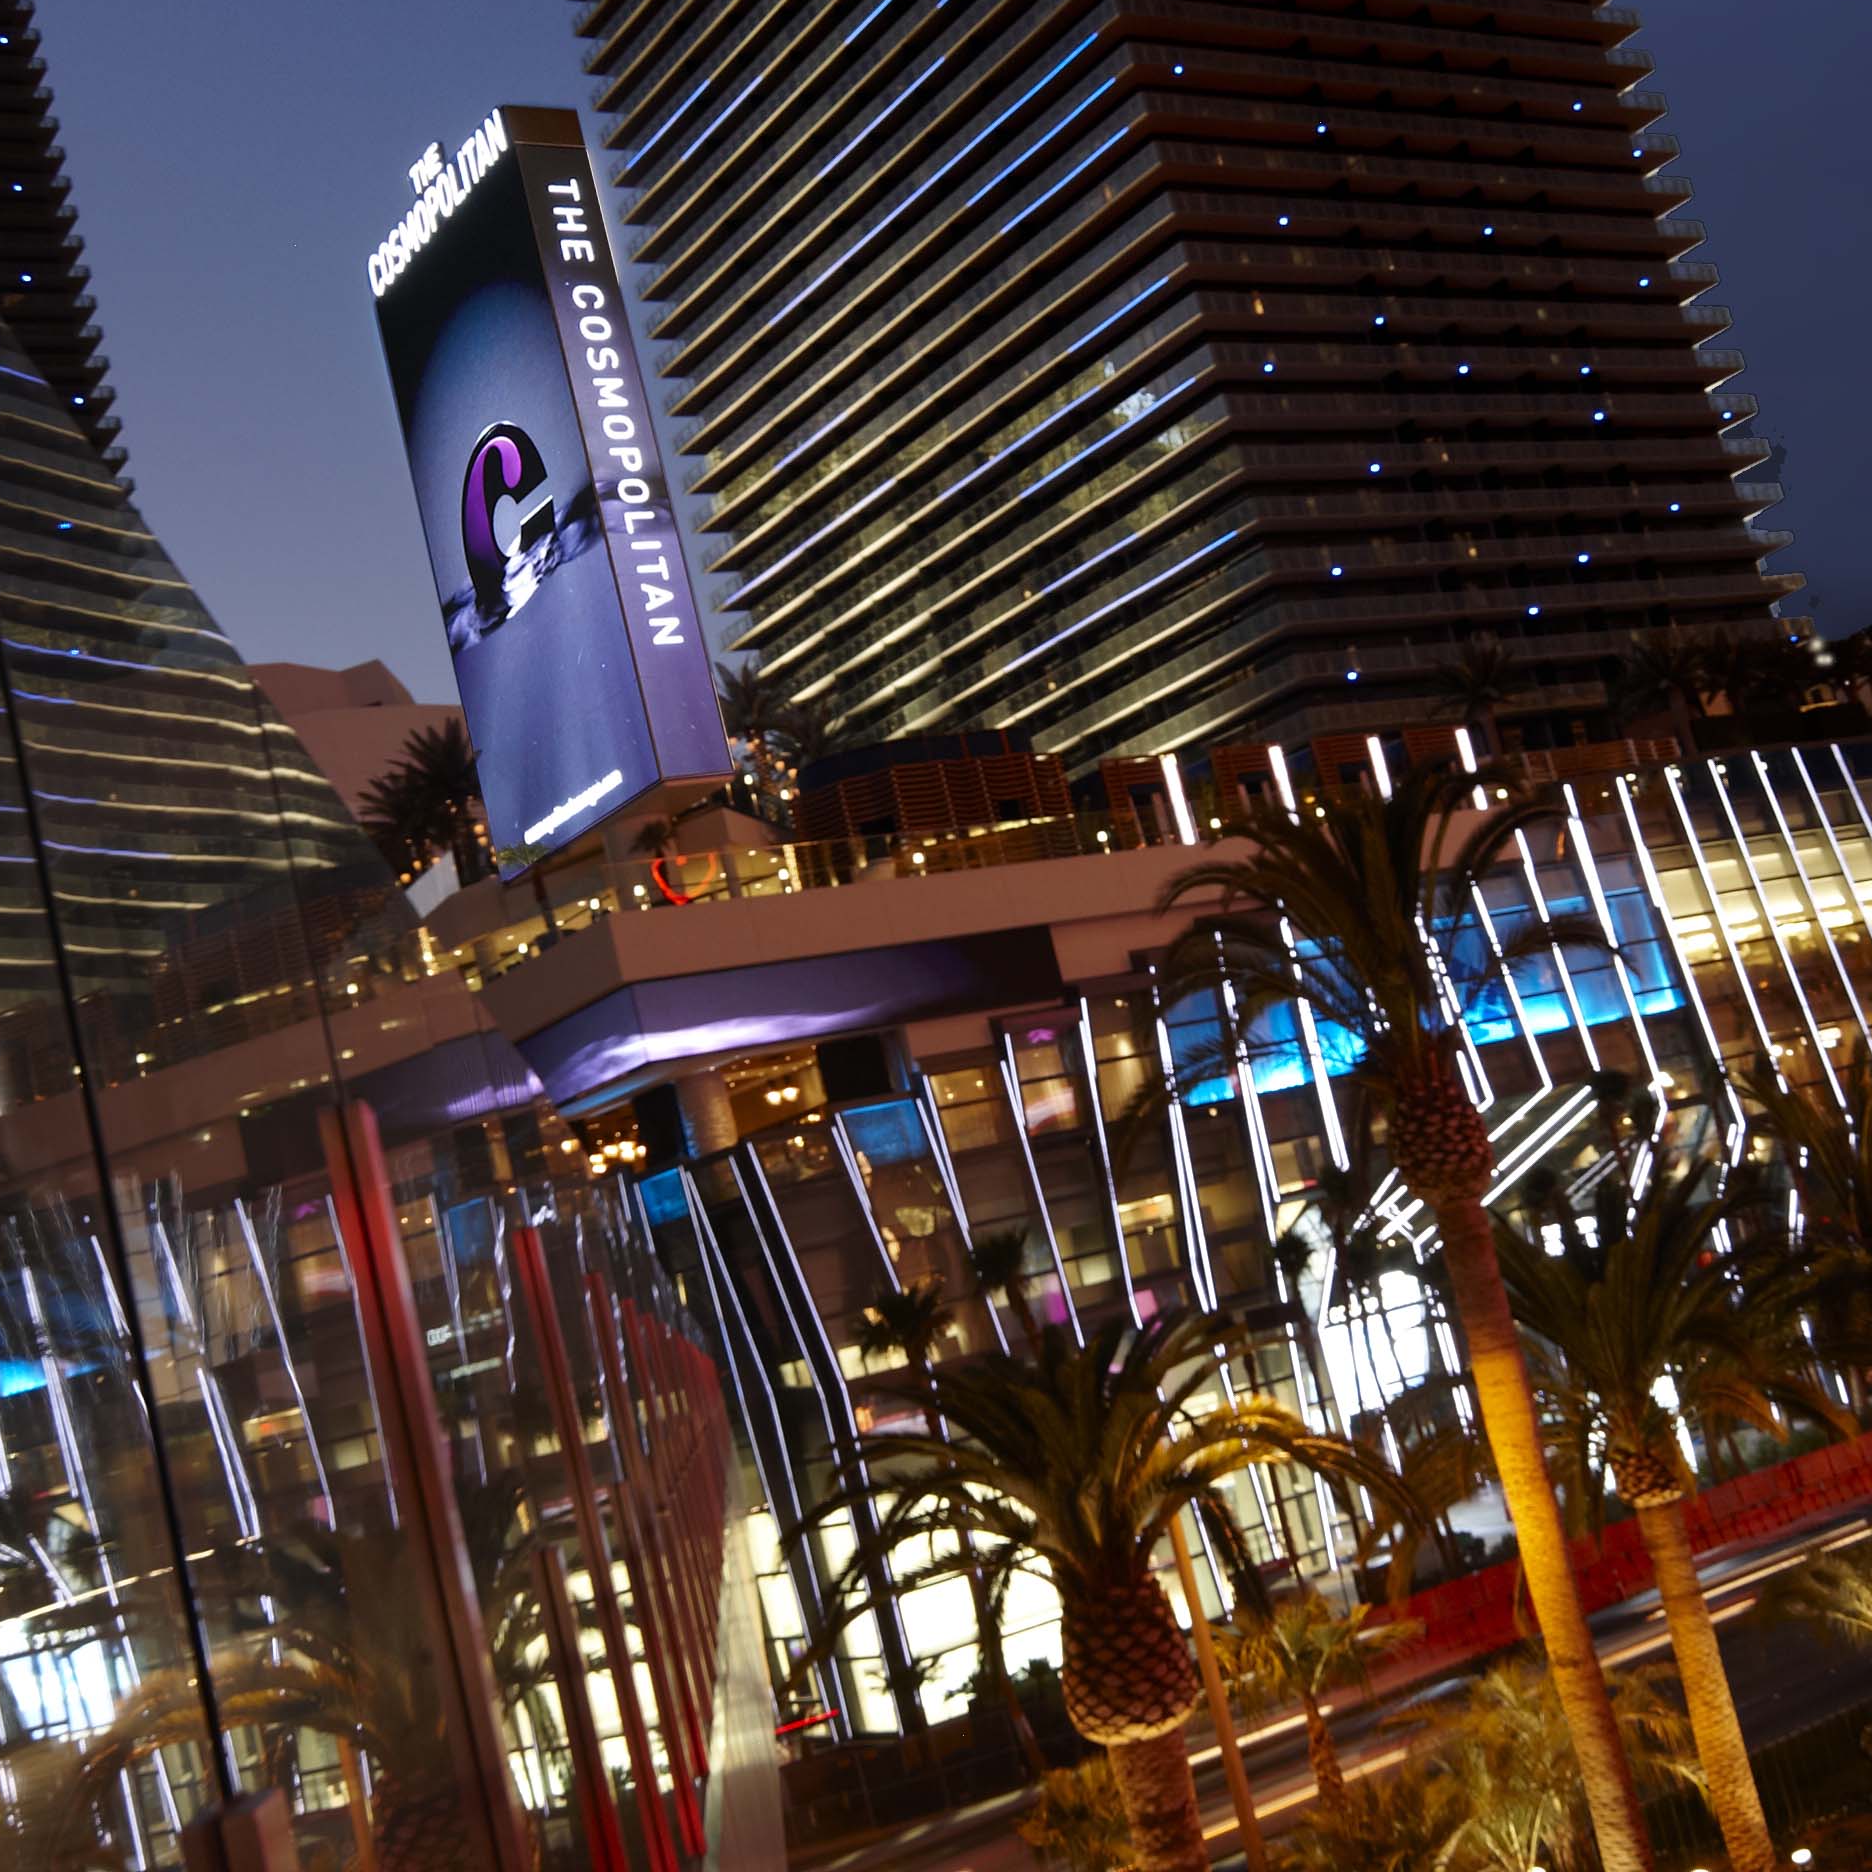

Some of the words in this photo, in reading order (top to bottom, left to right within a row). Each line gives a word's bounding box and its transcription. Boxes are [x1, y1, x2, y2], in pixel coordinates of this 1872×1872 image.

[367, 108, 509, 297] COSMOPOLITAN
[408, 141, 444, 195] THE
[546, 177, 595, 263] THE
[570, 283, 685, 646] COSMOPOLITAN
